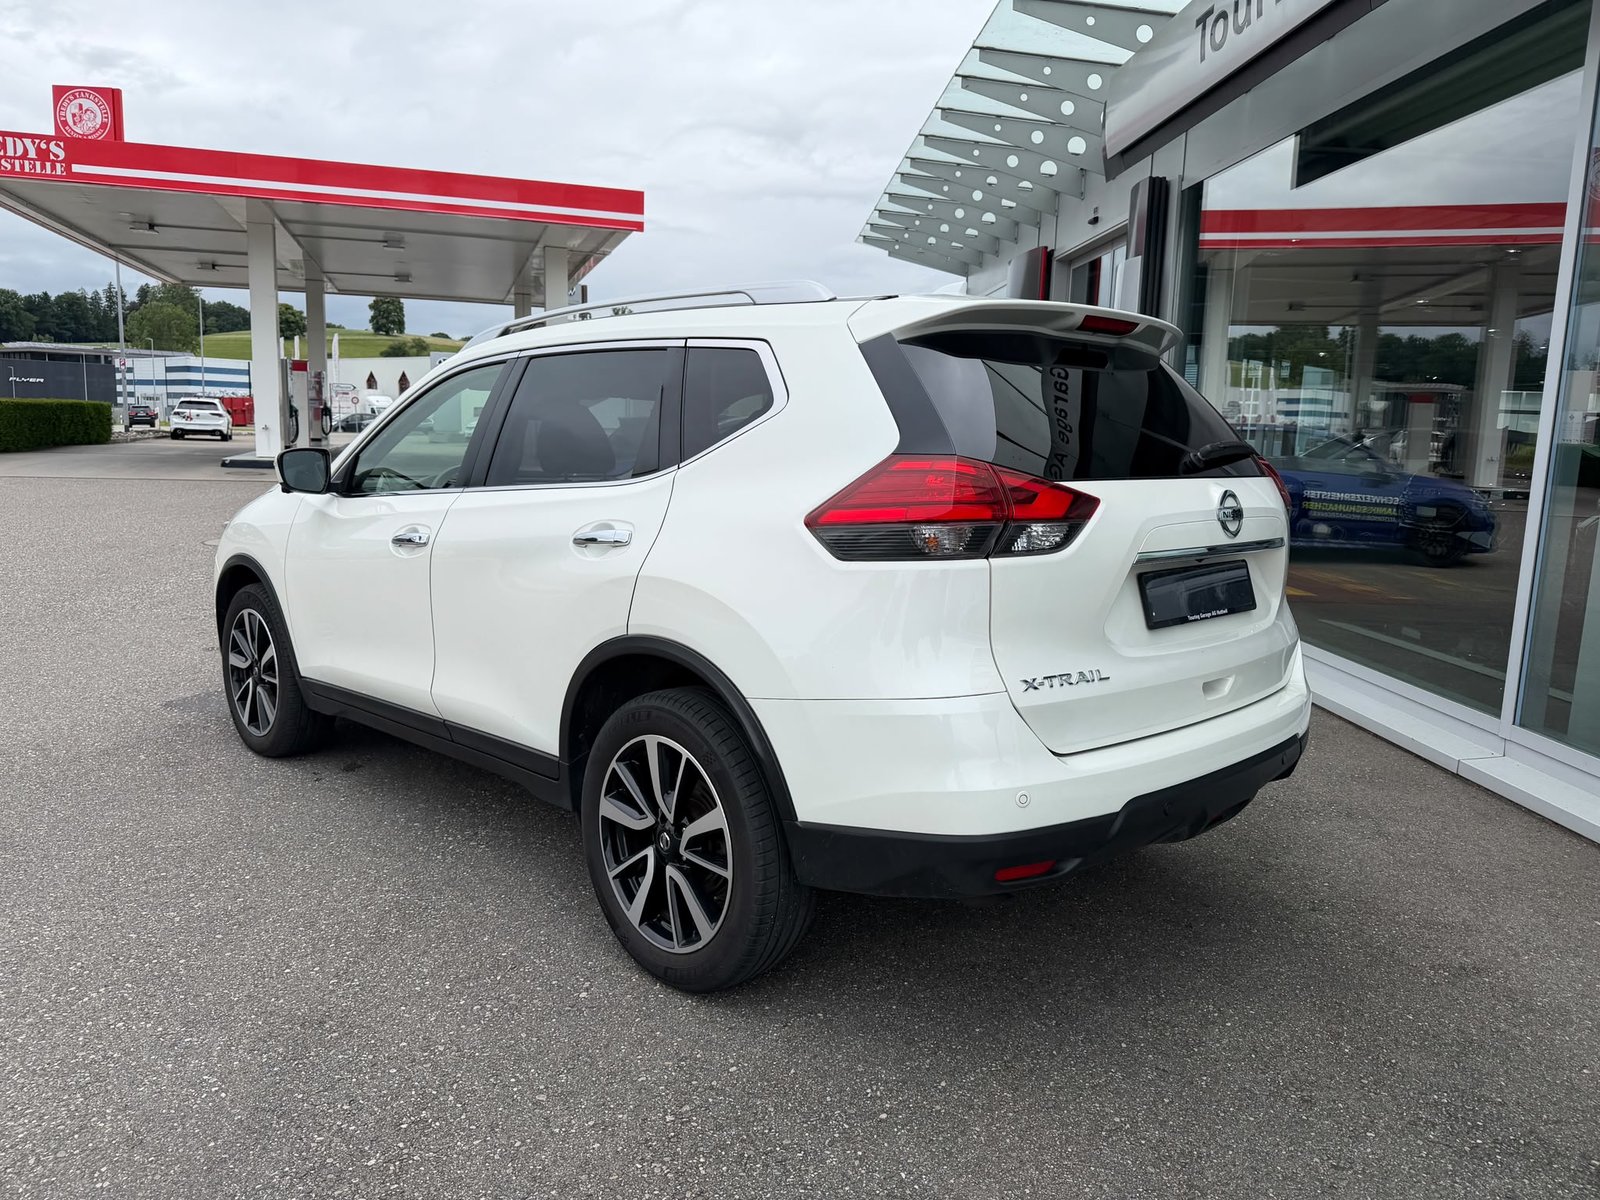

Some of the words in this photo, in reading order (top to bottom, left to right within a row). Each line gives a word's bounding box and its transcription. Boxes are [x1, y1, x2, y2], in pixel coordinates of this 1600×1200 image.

[1195, 0, 1281, 64] Tou
[75, 91, 109, 124] TANKSTELLE
[1020, 669, 1110, 693] X-TRAIL
